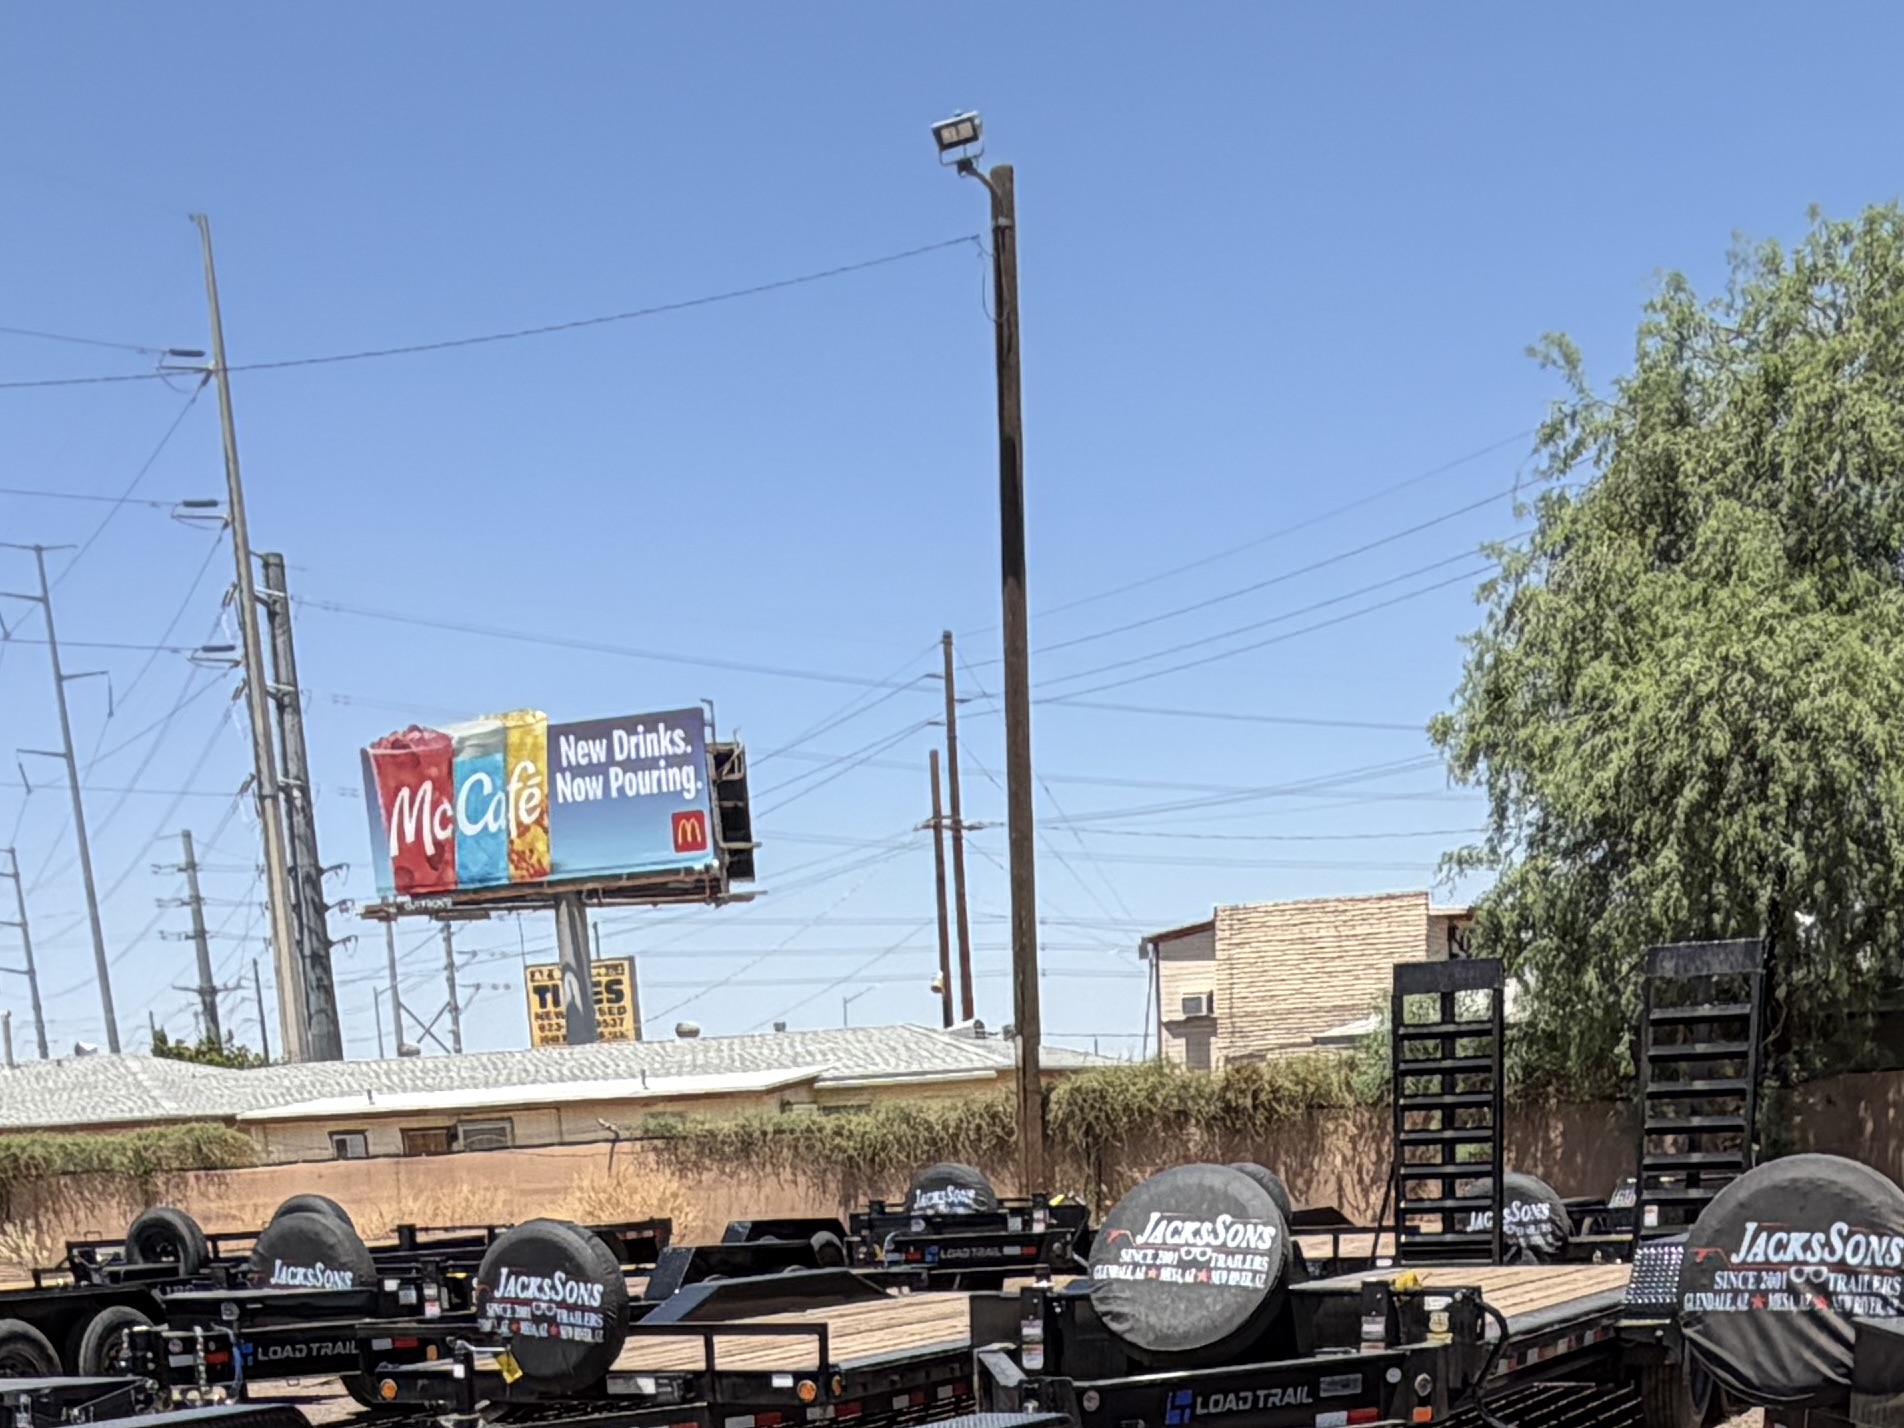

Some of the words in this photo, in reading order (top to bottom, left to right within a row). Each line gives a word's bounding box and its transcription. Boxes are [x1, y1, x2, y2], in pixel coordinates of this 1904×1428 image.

[559, 733, 608, 768] New
[612, 722, 692, 763] Drinks.
[556, 769, 605, 803] Now
[610, 762, 703, 799] Pouring.
[389, 760, 541, 858] McCafé
[533, 978, 625, 1009] TIES
[1120, 1249, 1155, 1264] SINCE
[1210, 1253, 1269, 1269] TRAILERS
[1714, 1271, 1755, 1290] SINCE
[1760, 1271, 1787, 1289] 2001
[1828, 1272, 1901, 1295] TRAILERS
[258, 1343, 307, 1361] LOAD
[310, 1341, 360, 1357] TRAIL
[1196, 1391, 1253, 1415] LOAD
[1256, 1386, 1313, 1408] TRAIL
